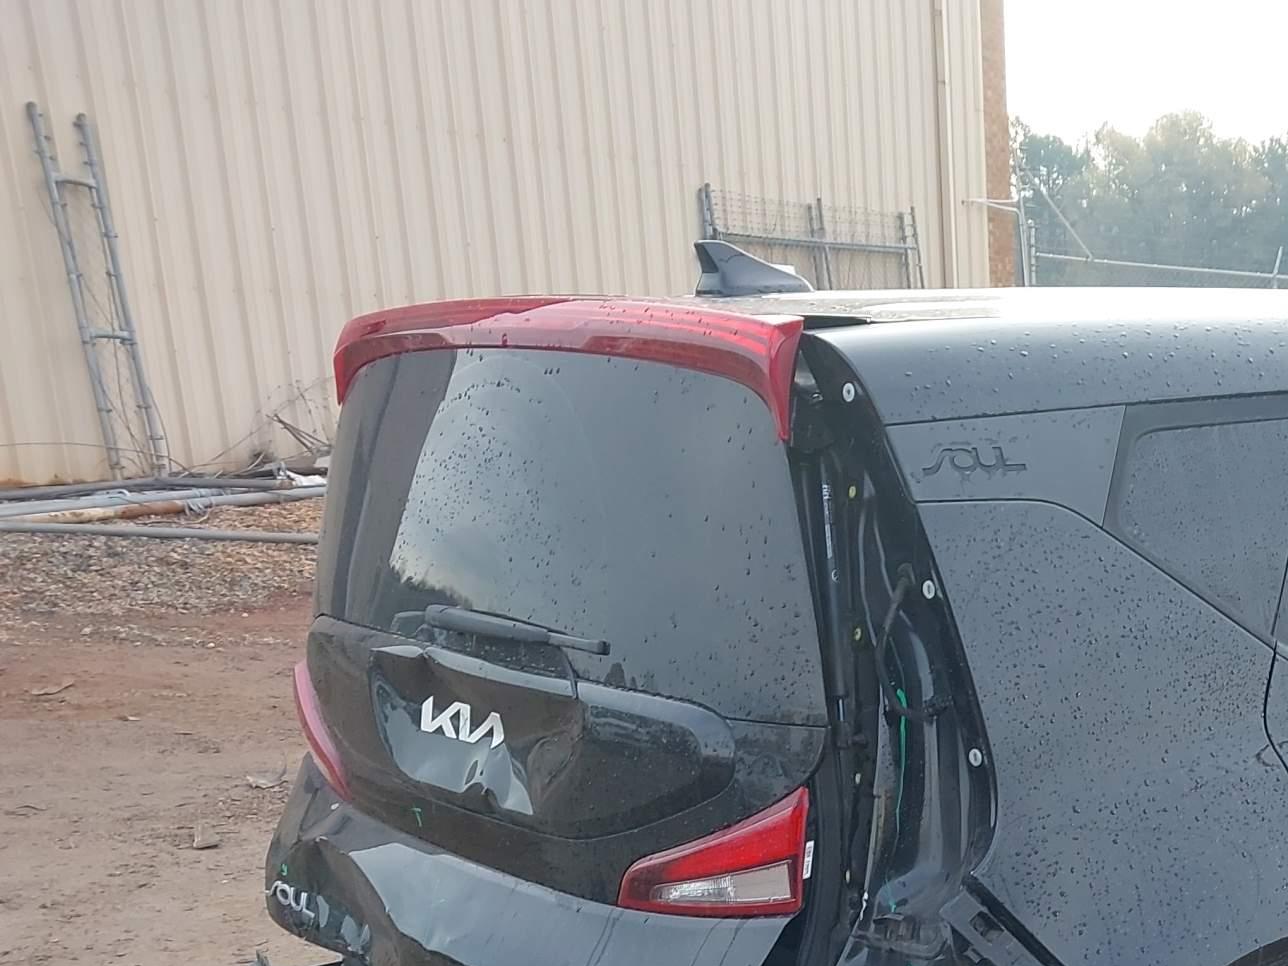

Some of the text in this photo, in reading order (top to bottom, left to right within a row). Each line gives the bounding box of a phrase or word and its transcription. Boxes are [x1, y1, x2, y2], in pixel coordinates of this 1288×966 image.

[921, 445, 1027, 477] SOUL
[420, 694, 505, 749] KIA
[264, 880, 316, 920] SOUL
